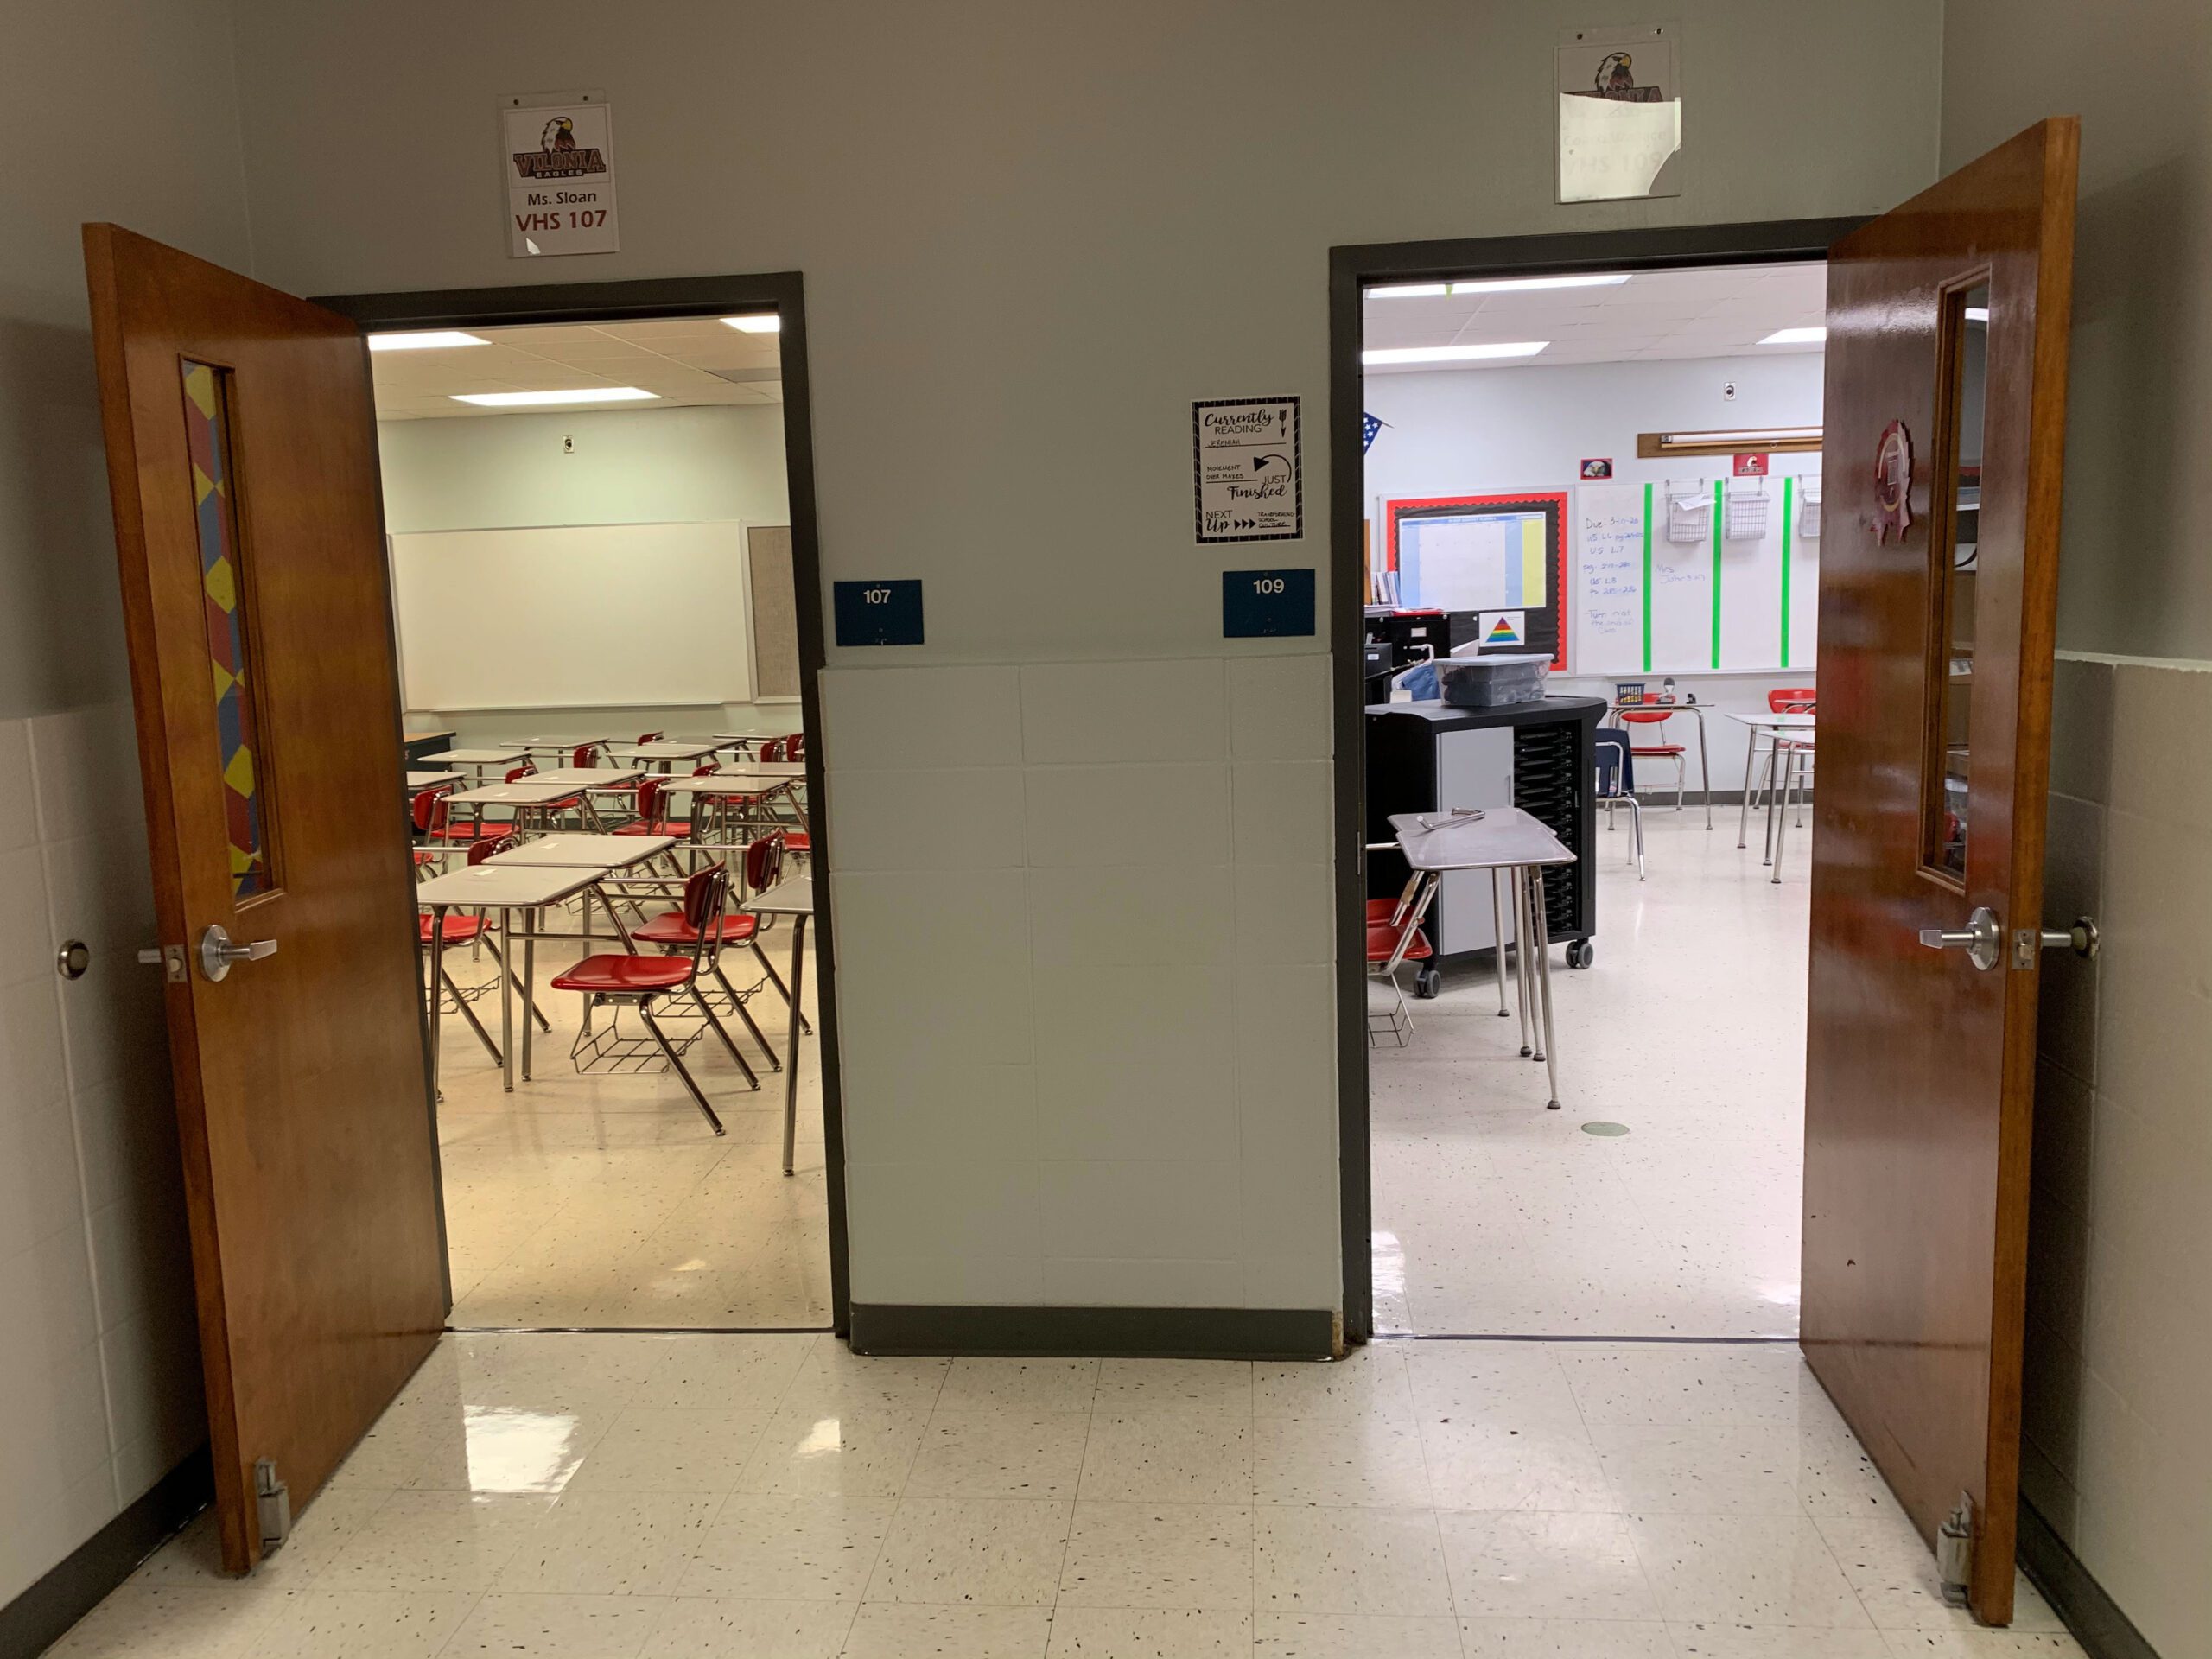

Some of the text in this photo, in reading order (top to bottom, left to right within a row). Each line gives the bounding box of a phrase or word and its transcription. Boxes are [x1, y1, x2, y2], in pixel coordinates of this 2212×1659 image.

[513, 149, 605, 178] VILONIA
[536, 169, 582, 178] EAGLES
[528, 191, 597, 206] Ms. Sloan
[515, 210, 607, 232] VHS 107
[1205, 409, 1275, 427] Currently
[1214, 424, 1262, 435] READING
[1207, 464, 1242, 473] MOVEMENT
[1262, 475, 1287, 485] JUST
[1227, 483, 1287, 501] Finished
[1206, 510, 1233, 519] NEXT
[1205, 518, 1230, 533] Up
[1253, 578, 1285, 594] 109
[863, 589, 892, 604] 107
